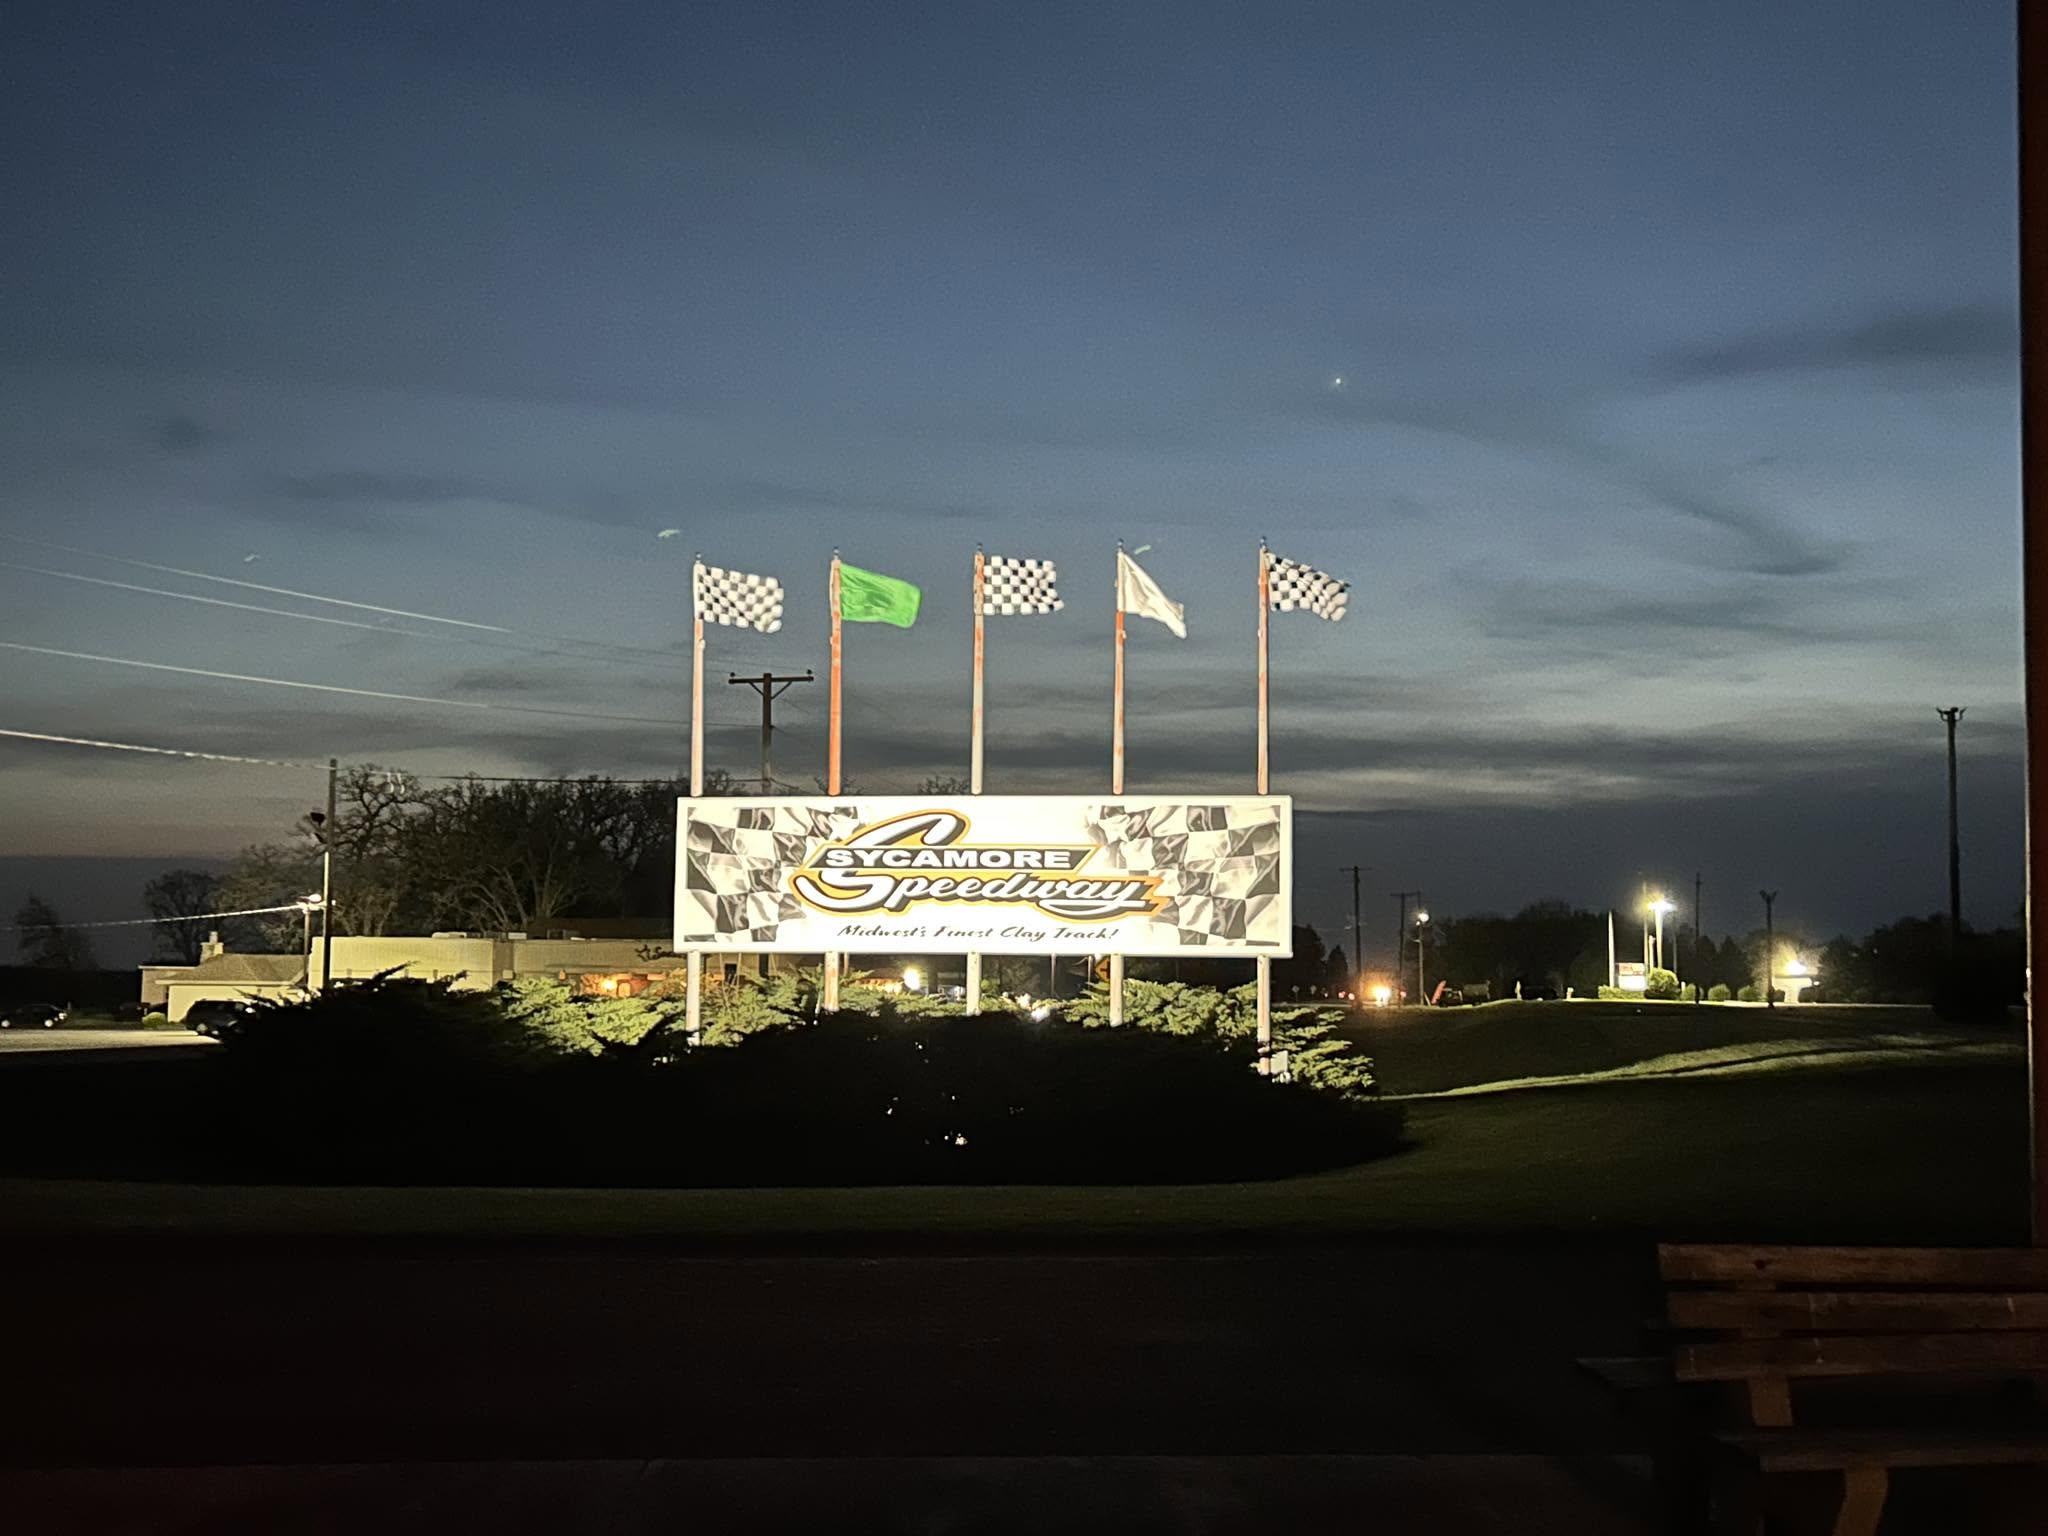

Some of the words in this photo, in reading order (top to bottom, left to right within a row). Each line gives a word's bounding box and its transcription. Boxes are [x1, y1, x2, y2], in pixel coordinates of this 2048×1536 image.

[824, 849, 1072, 869] SYCAMORE
[836, 924, 927, 938] Midwest's
[934, 925, 994, 938] Finest
[999, 926, 1047, 943] Clay
[1053, 927, 1120, 940] Track!
